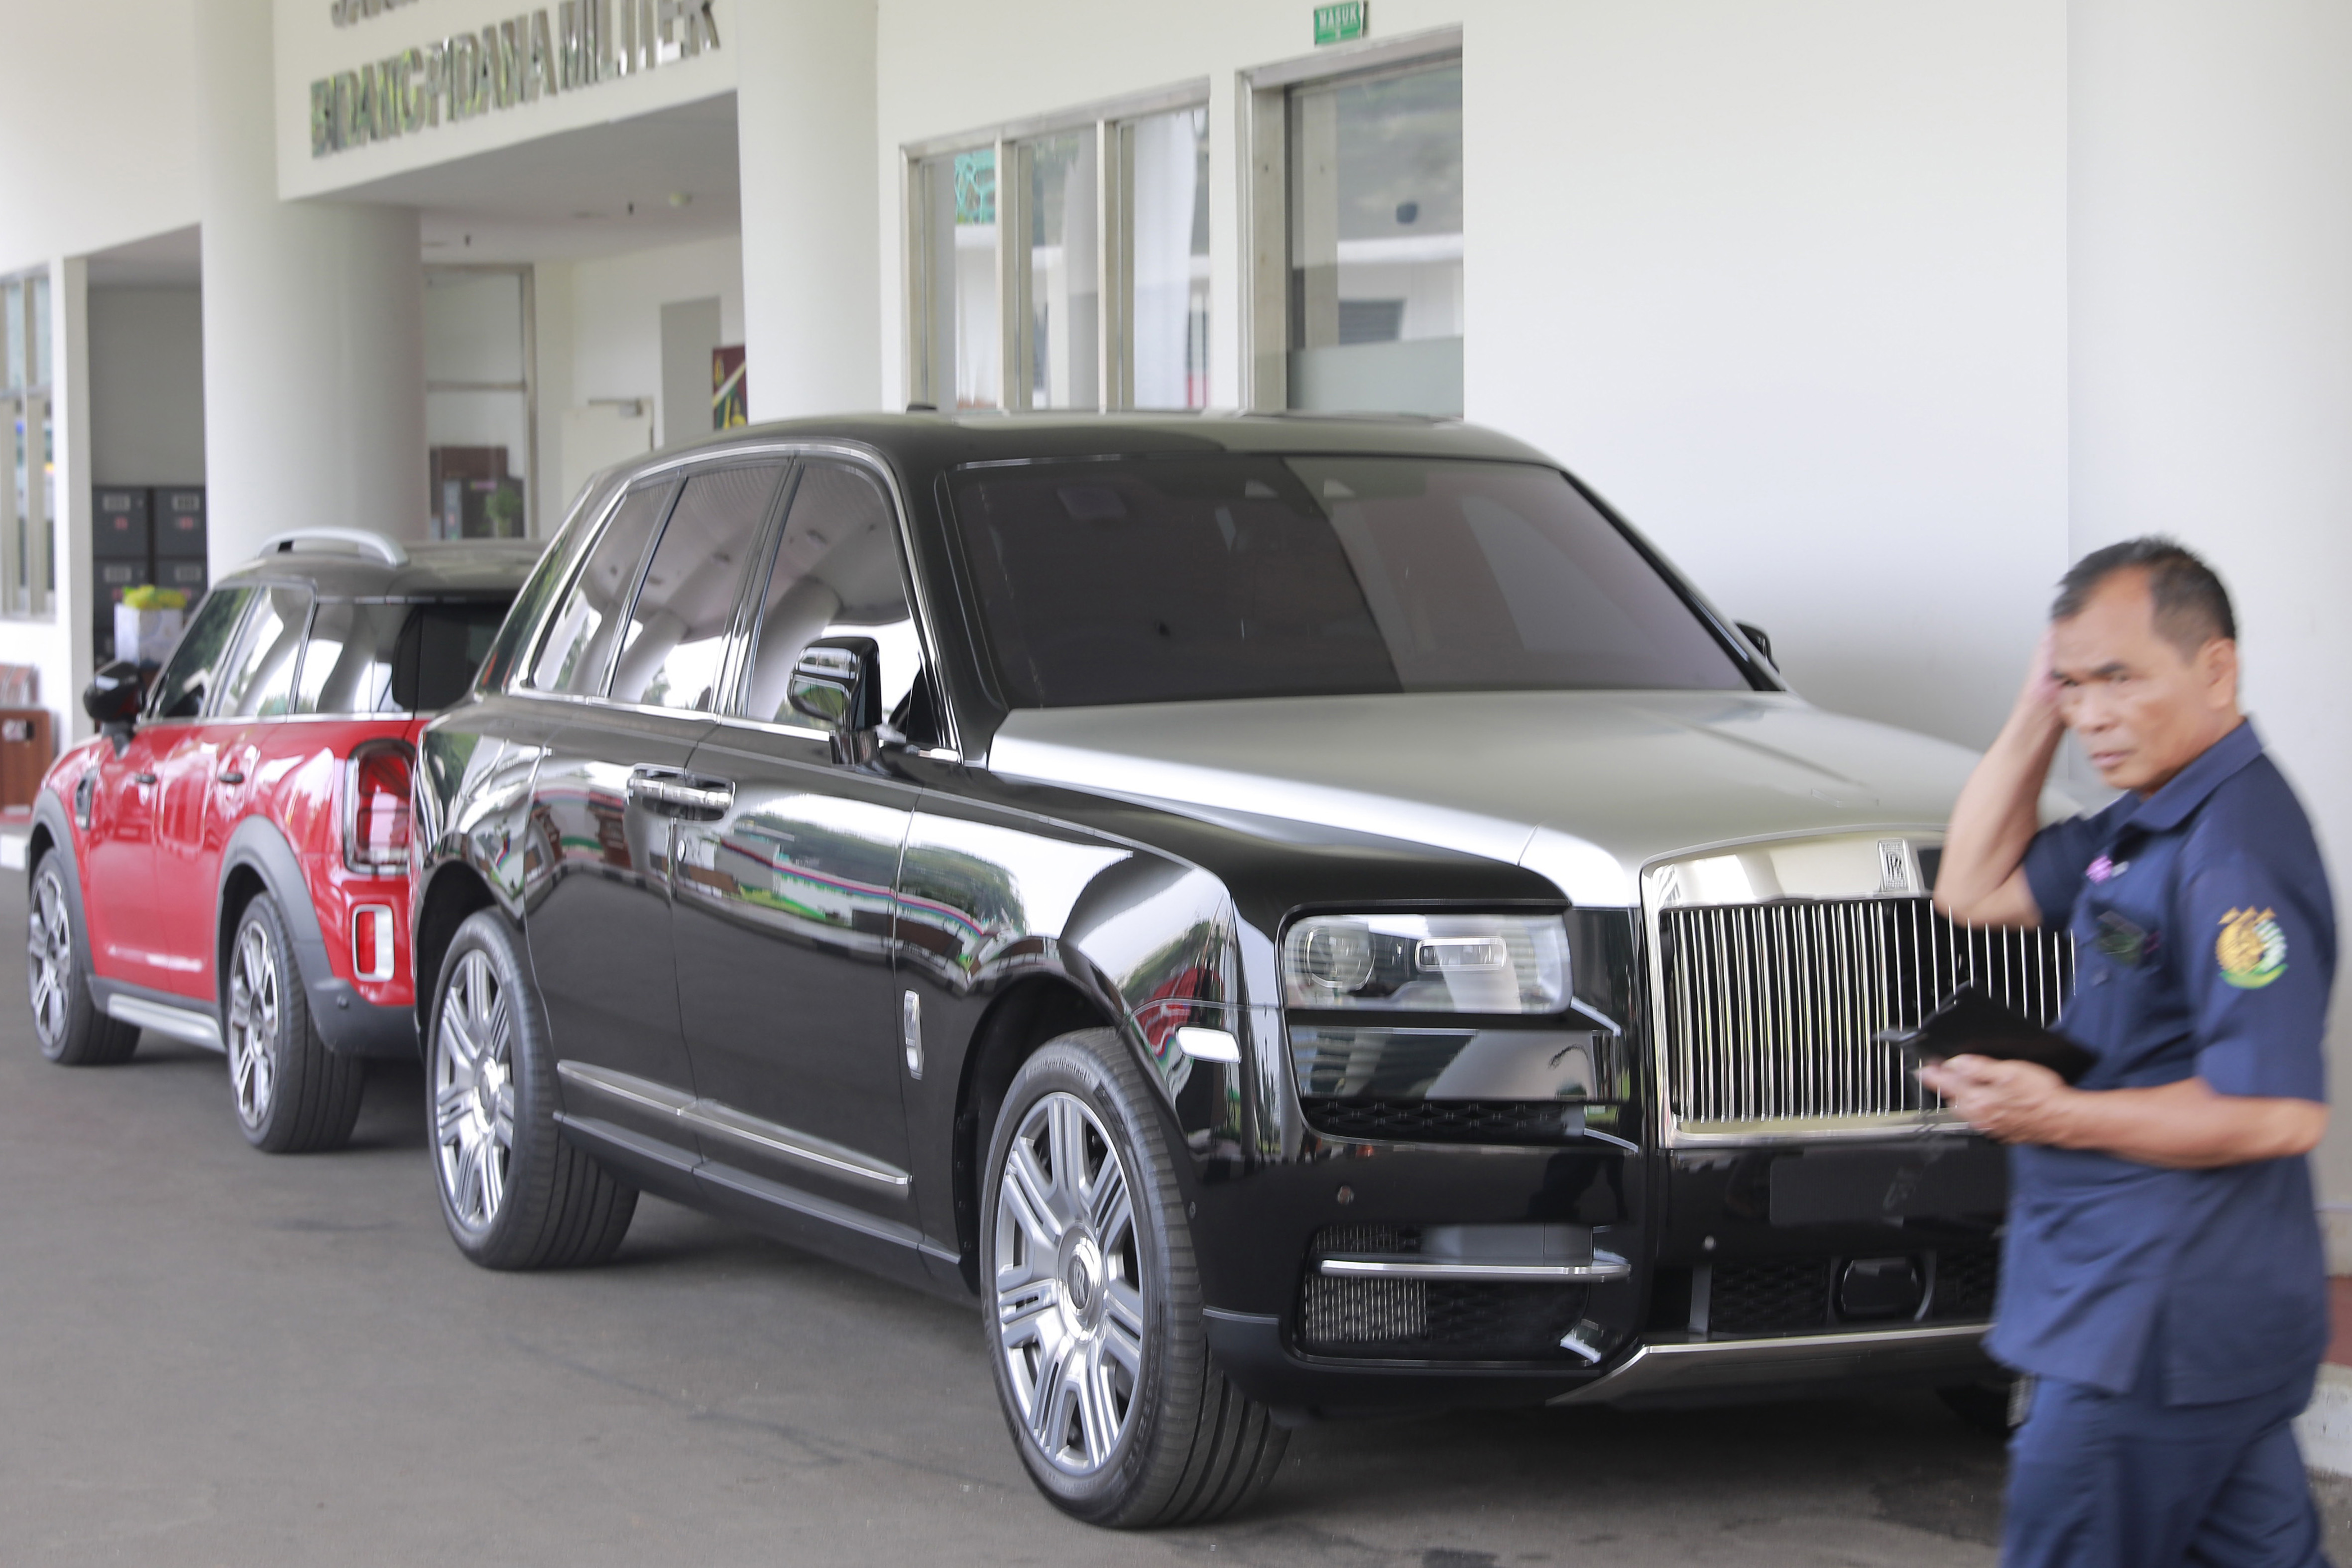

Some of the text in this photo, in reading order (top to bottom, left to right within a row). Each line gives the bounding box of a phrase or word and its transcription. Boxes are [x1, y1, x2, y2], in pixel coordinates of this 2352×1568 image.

[1320, 5, 1357, 29] MASUK
[311, 48, 424, 158] BIDANG
[424, 9, 557, 127] PIDANA
